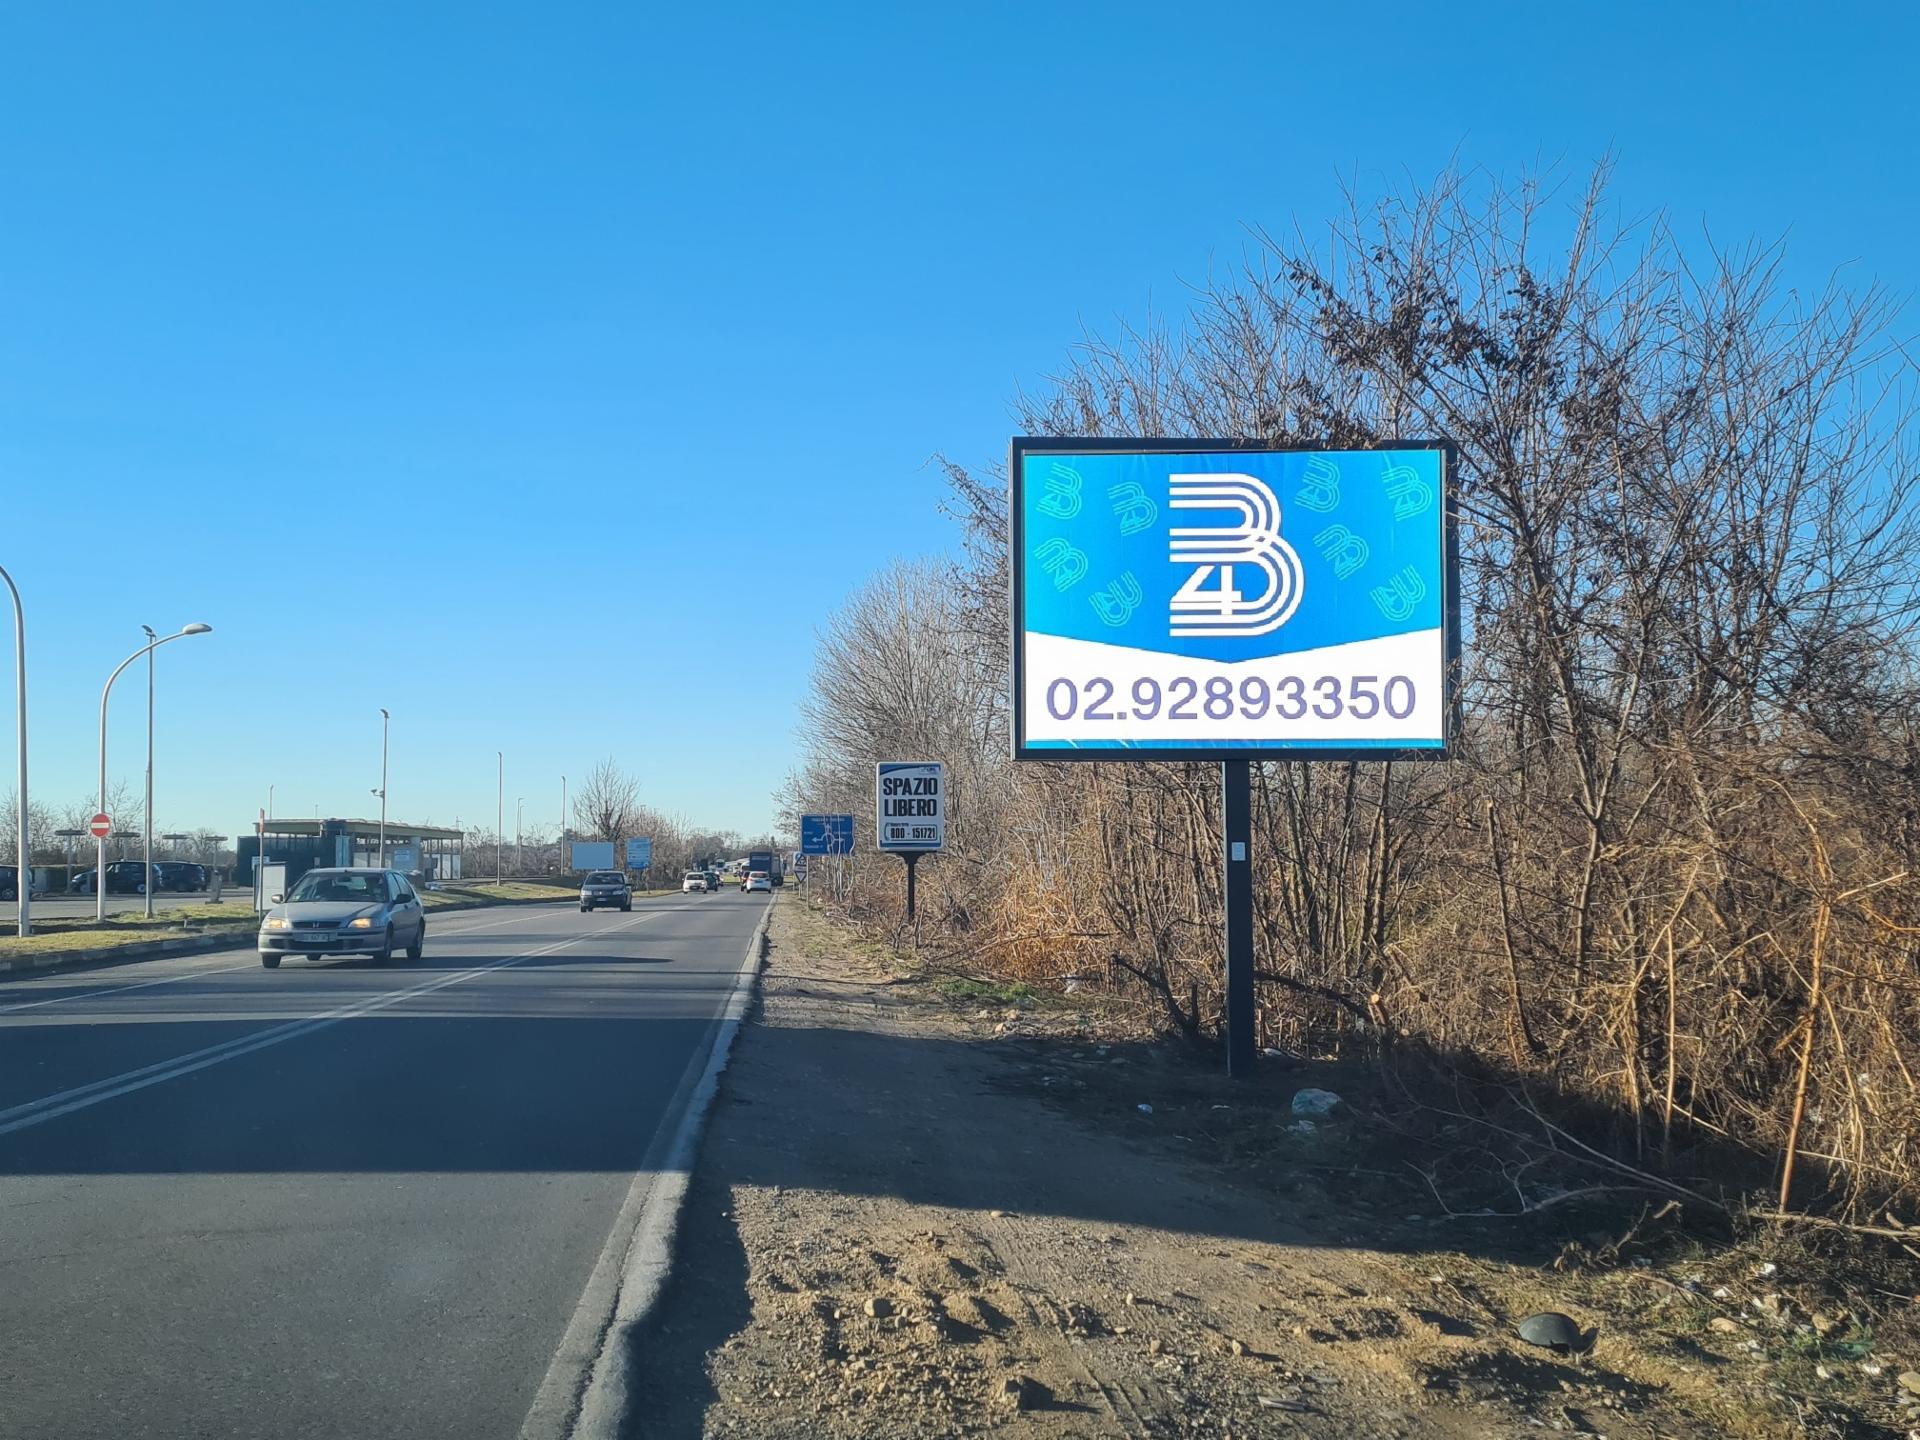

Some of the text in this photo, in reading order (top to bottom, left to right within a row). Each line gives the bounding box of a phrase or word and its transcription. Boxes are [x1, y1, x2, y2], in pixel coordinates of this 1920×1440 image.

[1046, 675, 1416, 721] 02.92893350
[883, 778, 938, 796] SPAZIO
[884, 798, 937, 817] LIBERO
